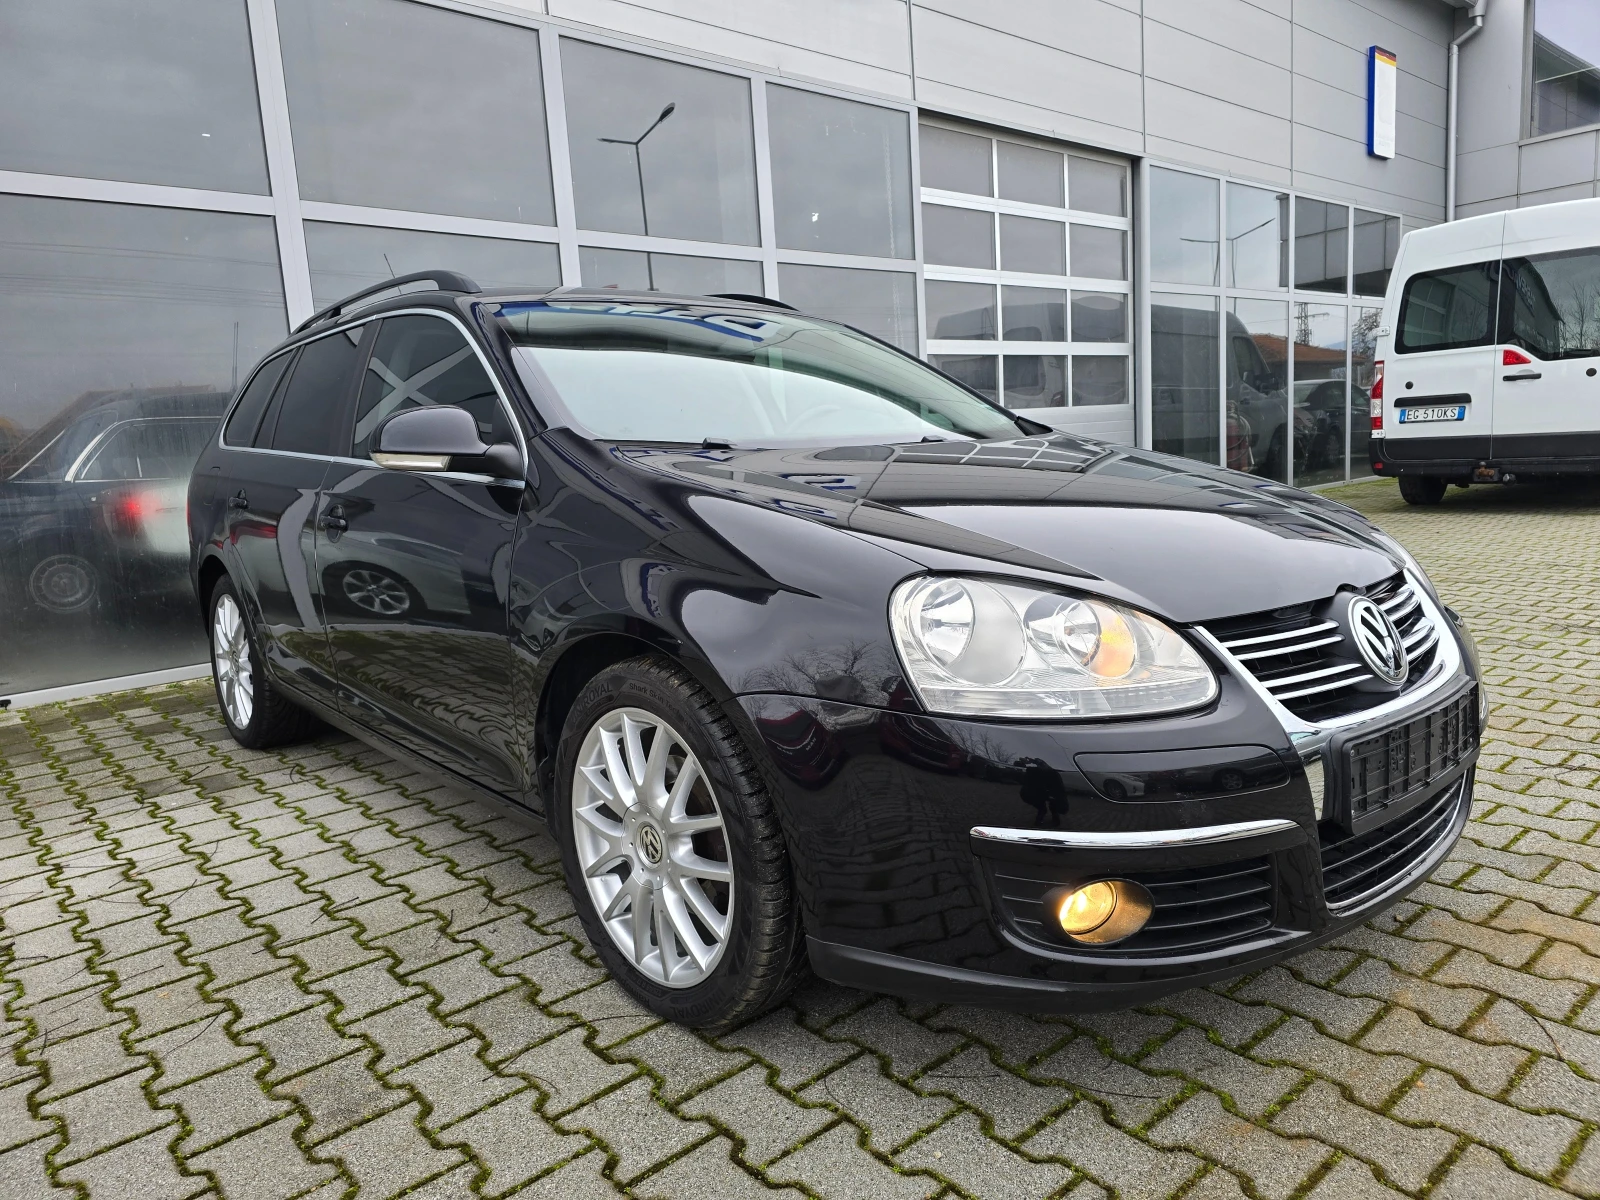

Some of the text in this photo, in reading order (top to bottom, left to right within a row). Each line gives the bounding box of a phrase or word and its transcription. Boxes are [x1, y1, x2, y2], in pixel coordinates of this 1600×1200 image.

[1406, 408, 1457, 420] EG 510KS
[570, 681, 613, 723] UNIROYAL
[629, 682, 648, 695] Shark
[649, 689, 665, 704] Skin
[669, 987, 727, 1020] UNIROYAL
